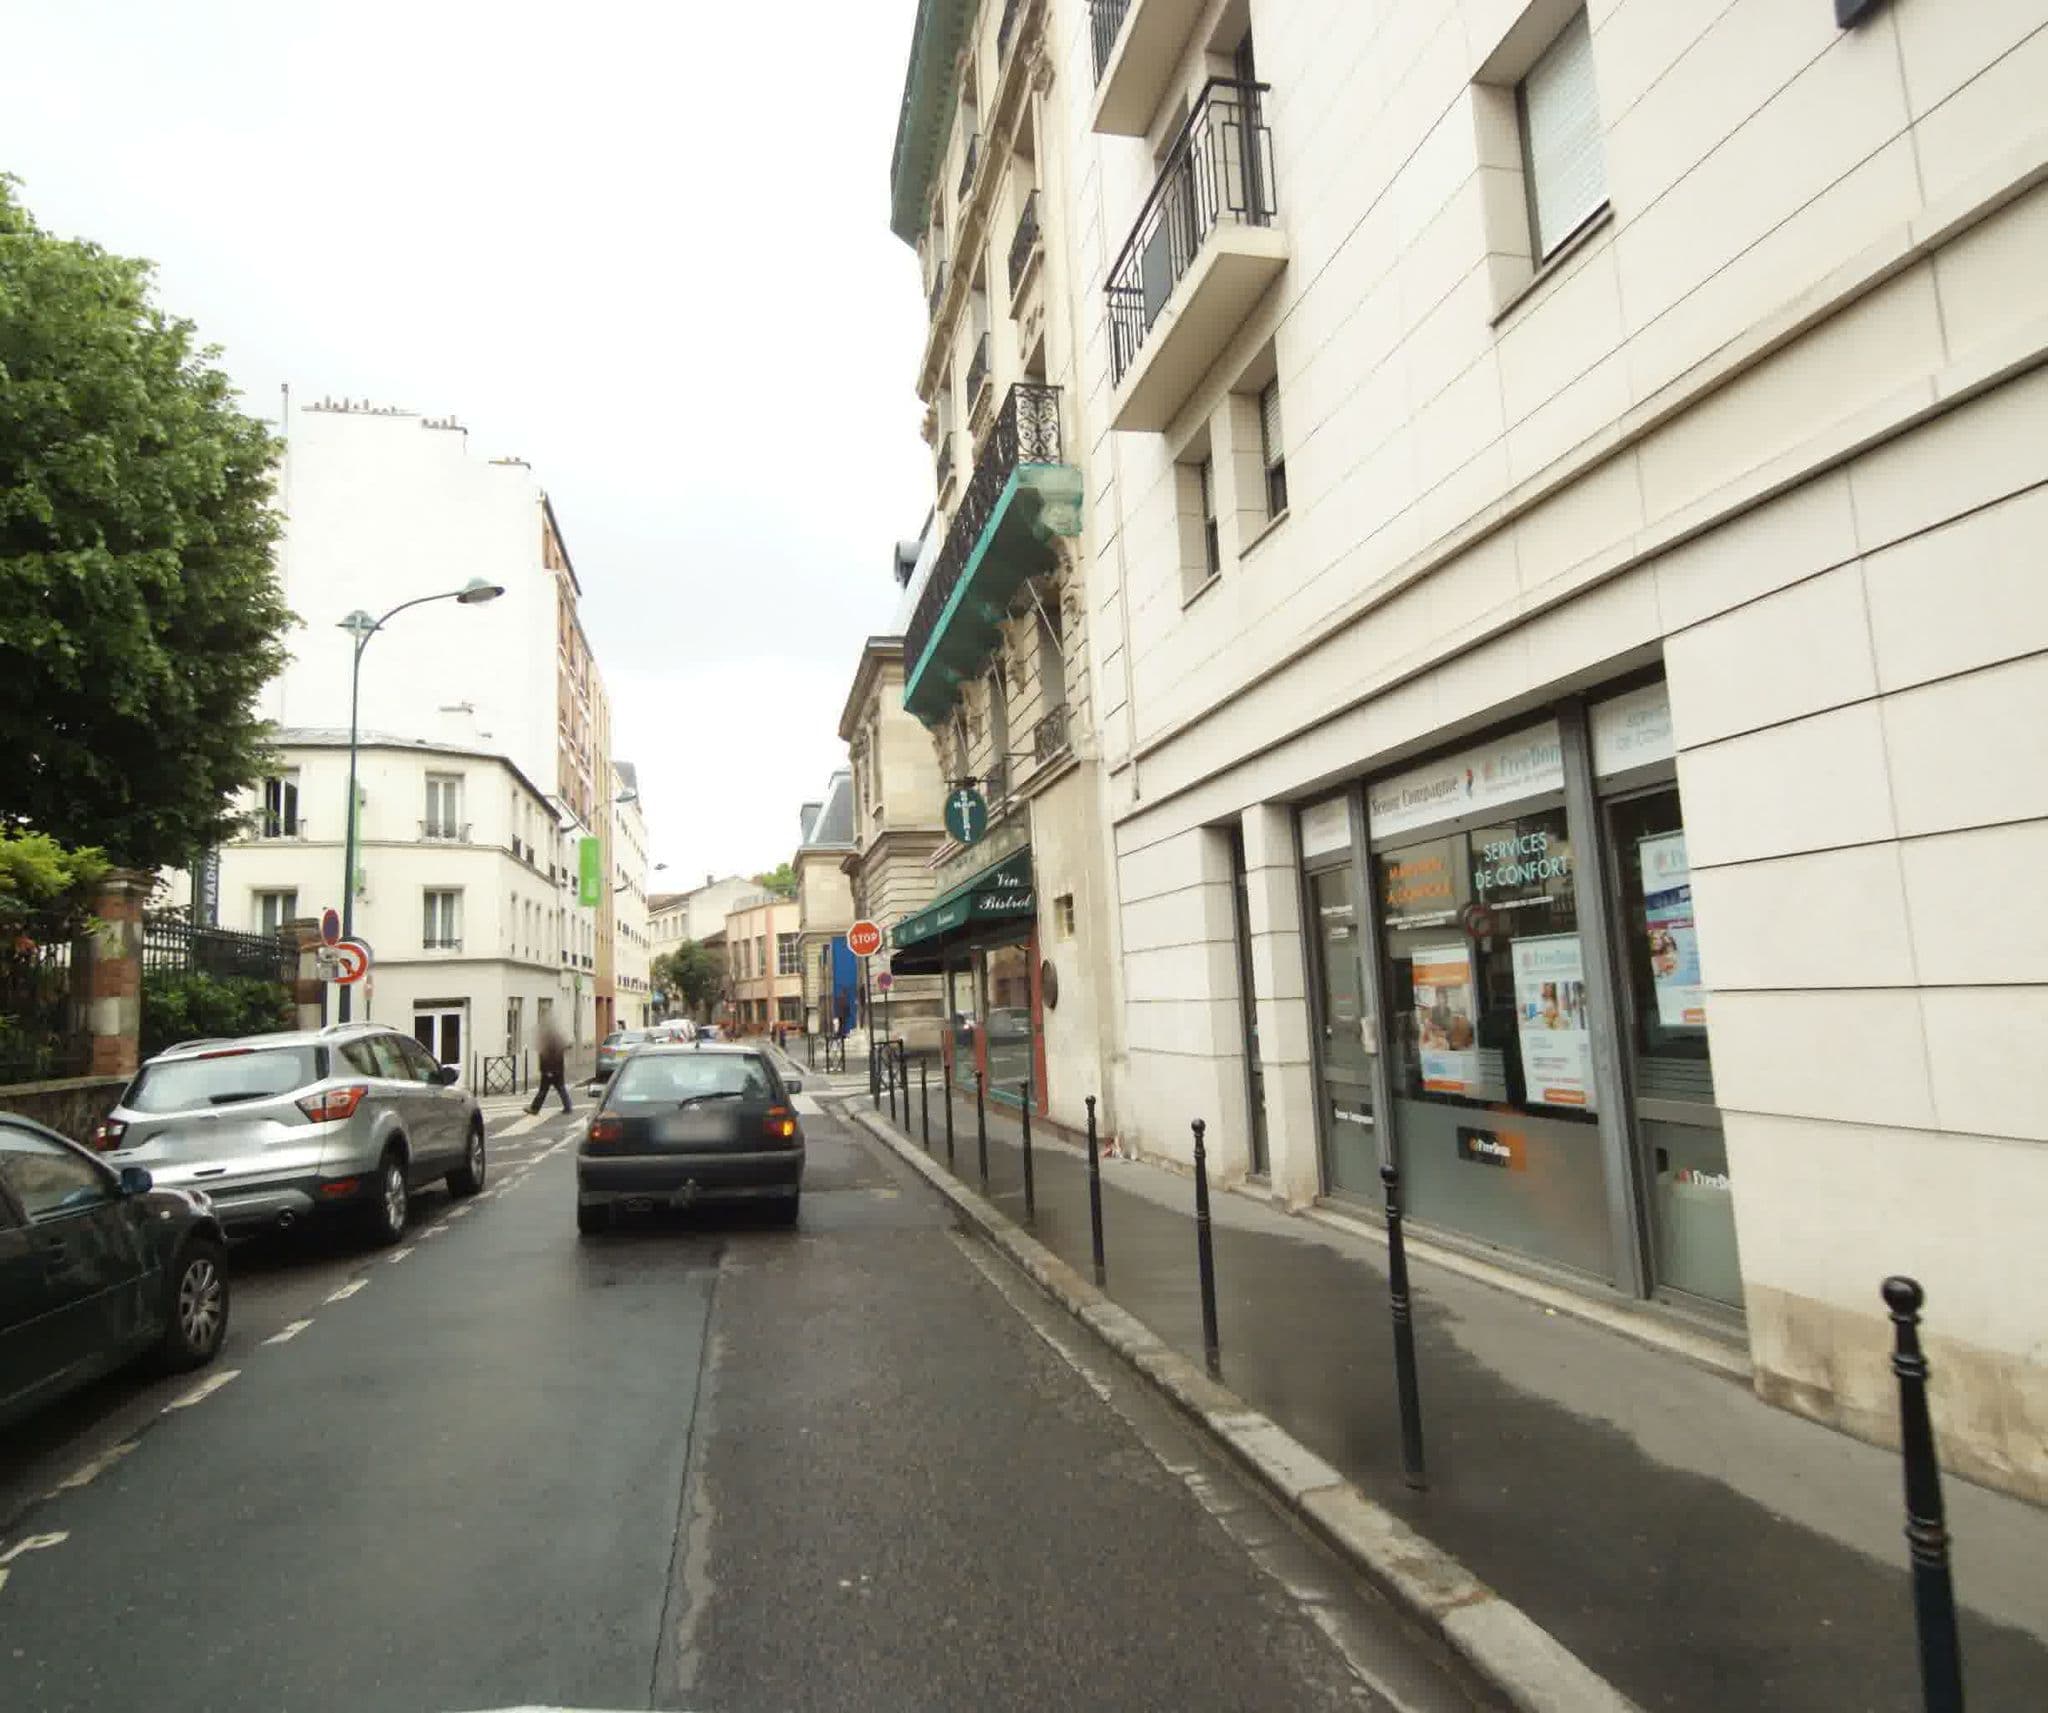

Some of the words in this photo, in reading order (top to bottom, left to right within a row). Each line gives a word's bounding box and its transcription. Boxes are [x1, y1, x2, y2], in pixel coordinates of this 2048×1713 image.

[1483, 831, 1548, 862] SERVICES
[997, 870, 1019, 887] Vin
[1475, 869, 1493, 890] DE
[1496, 855, 1568, 886] CONFORT
[980, 893, 1032, 910] Bistrot
[851, 932, 878, 946] STOP
